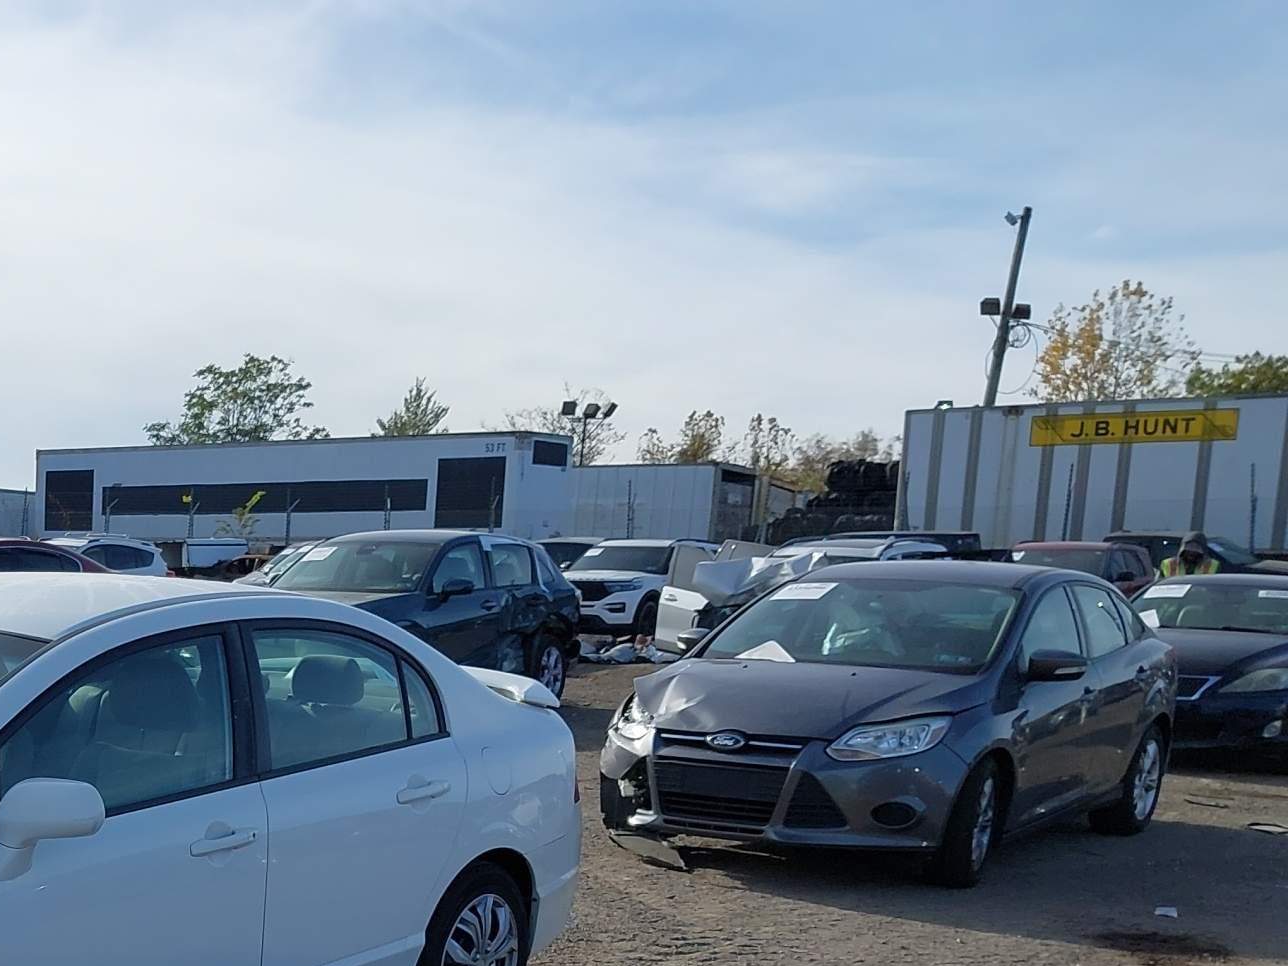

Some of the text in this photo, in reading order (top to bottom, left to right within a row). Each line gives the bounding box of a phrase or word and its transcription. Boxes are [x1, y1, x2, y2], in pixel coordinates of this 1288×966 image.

[1070, 417, 1196, 438] J.B. HUNT
[484, 442, 507, 453] 53 FT
